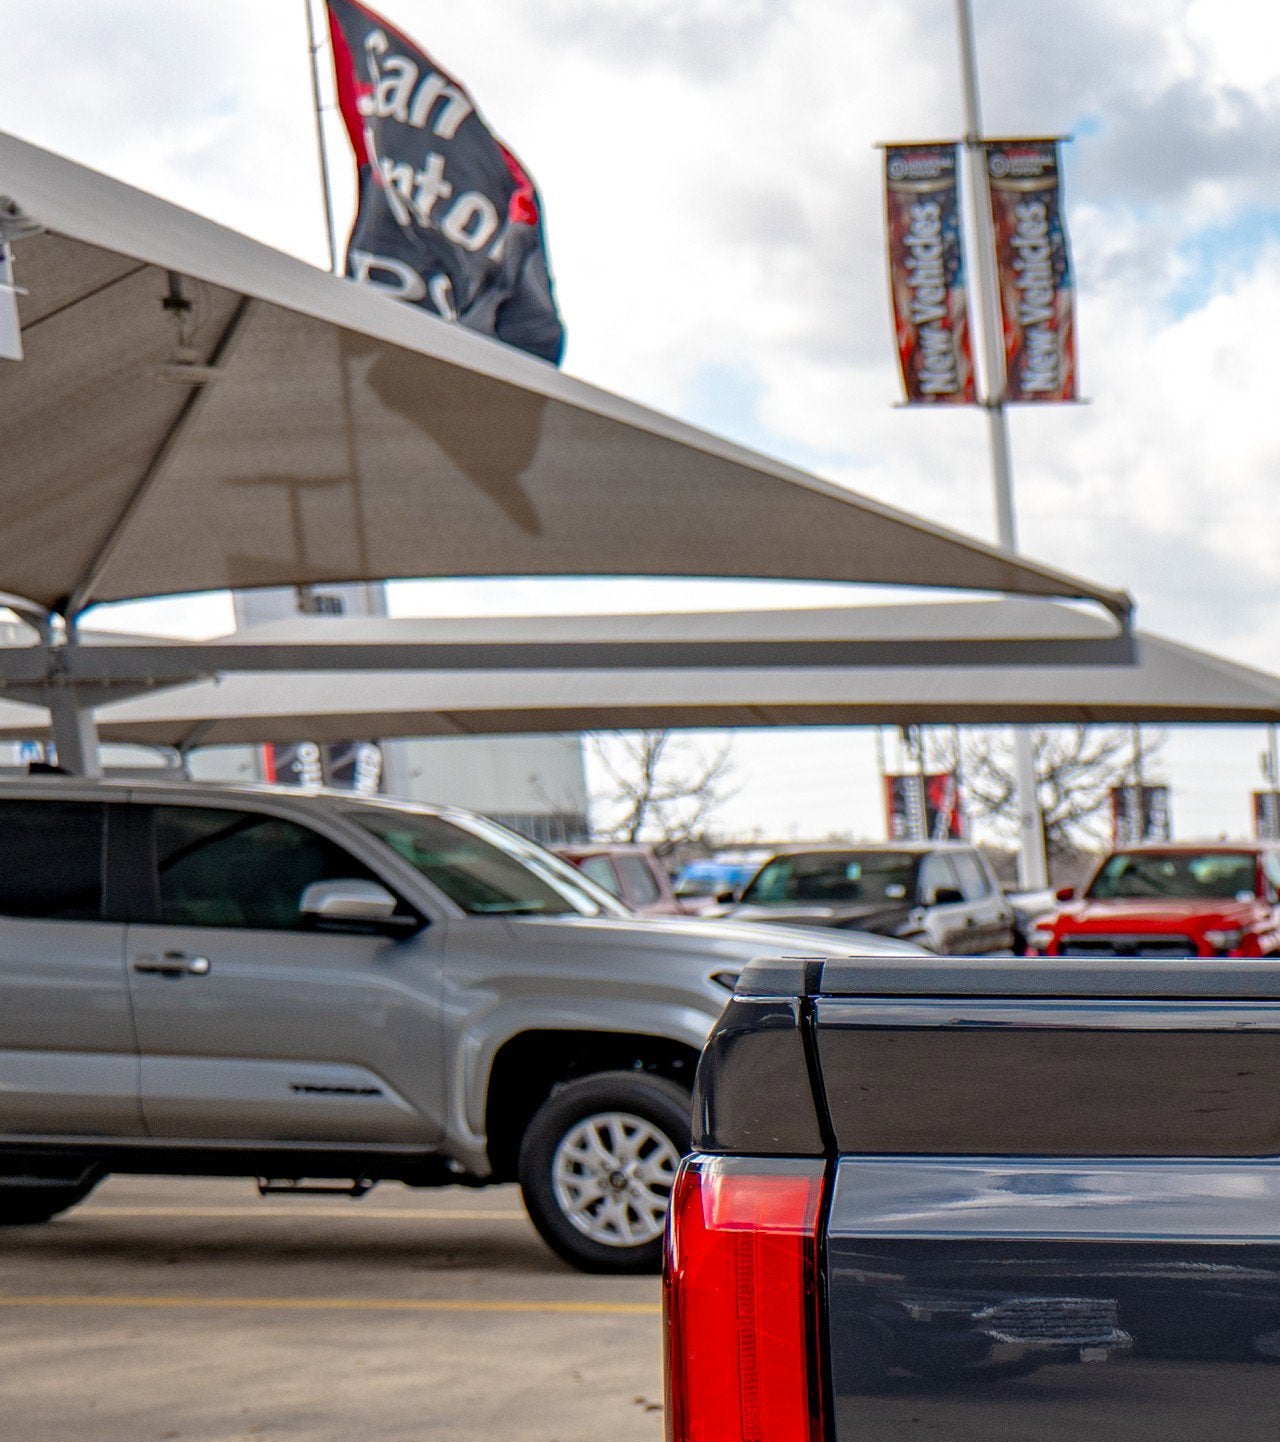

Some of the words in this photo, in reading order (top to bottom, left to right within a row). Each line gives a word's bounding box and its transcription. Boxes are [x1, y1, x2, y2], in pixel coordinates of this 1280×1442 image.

[901, 199, 948, 325] Vehicles
[1008, 199, 1055, 326] Vehicles
[917, 327, 959, 394] New
[1019, 326, 1058, 393] New
